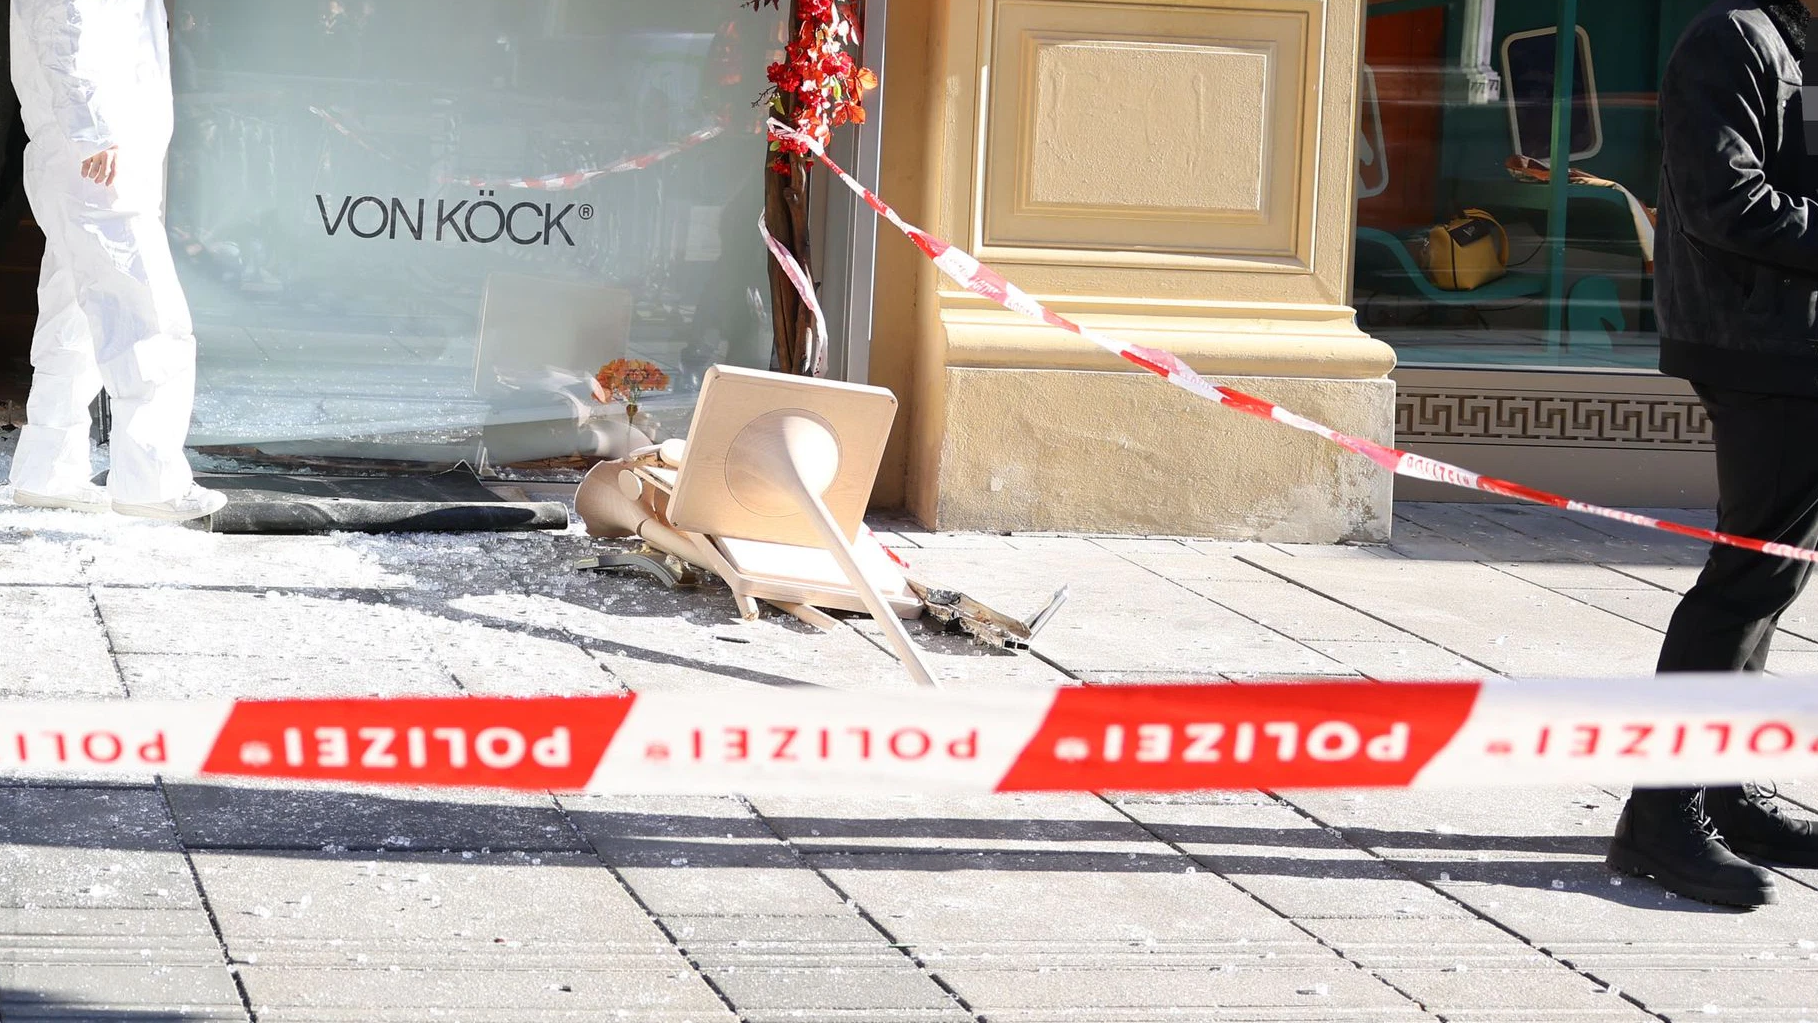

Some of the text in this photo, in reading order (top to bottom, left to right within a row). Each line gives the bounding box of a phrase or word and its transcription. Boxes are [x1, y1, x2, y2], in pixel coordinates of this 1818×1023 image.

[315, 194, 425, 241] VON
[282, 726, 572, 769] POLIZEI
[692, 725, 978, 763] POLIZEI
[1103, 720, 1411, 764] POLIZEI
[1534, 720, 1818, 758] OLIZEI
